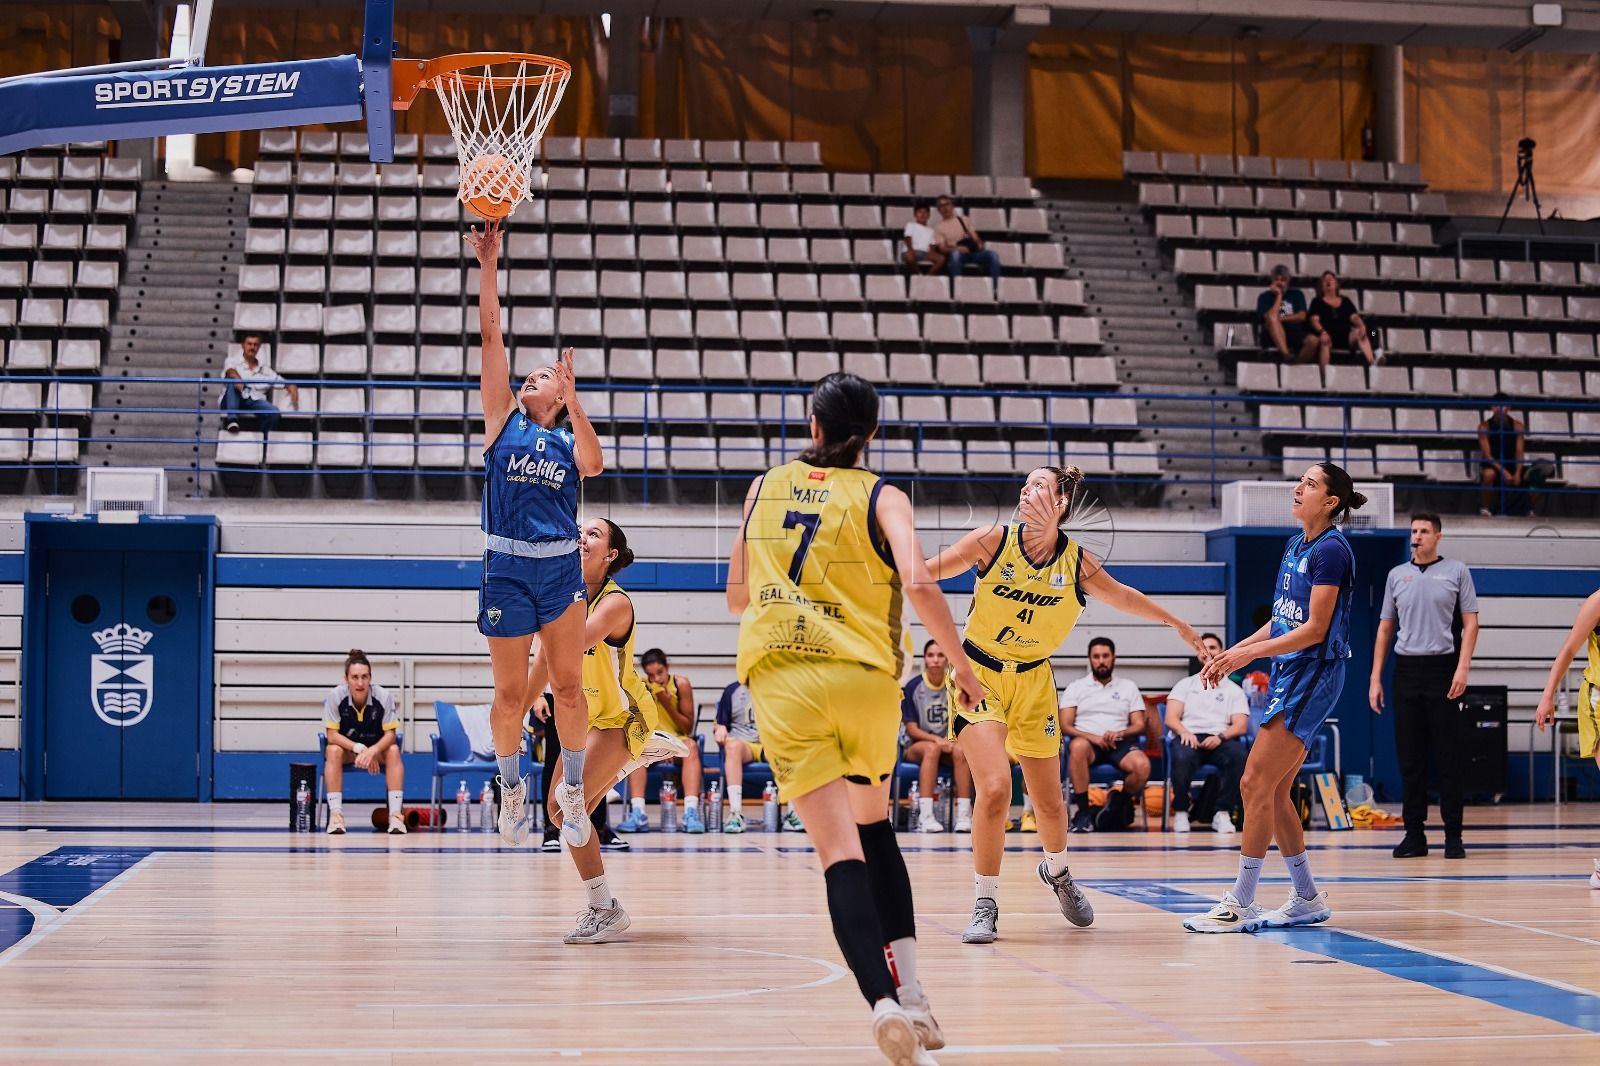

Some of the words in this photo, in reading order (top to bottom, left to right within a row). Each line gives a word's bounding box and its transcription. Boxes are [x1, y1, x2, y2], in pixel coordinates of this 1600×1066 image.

[535, 437, 546, 452] 6
[506, 453, 567, 483] Melilla
[793, 485, 830, 503] MATO
[783, 510, 822, 586] 7
[760, 587, 784, 601] REAL
[992, 584, 1064, 607] CANOE
[1016, 607, 1034, 625] 41
